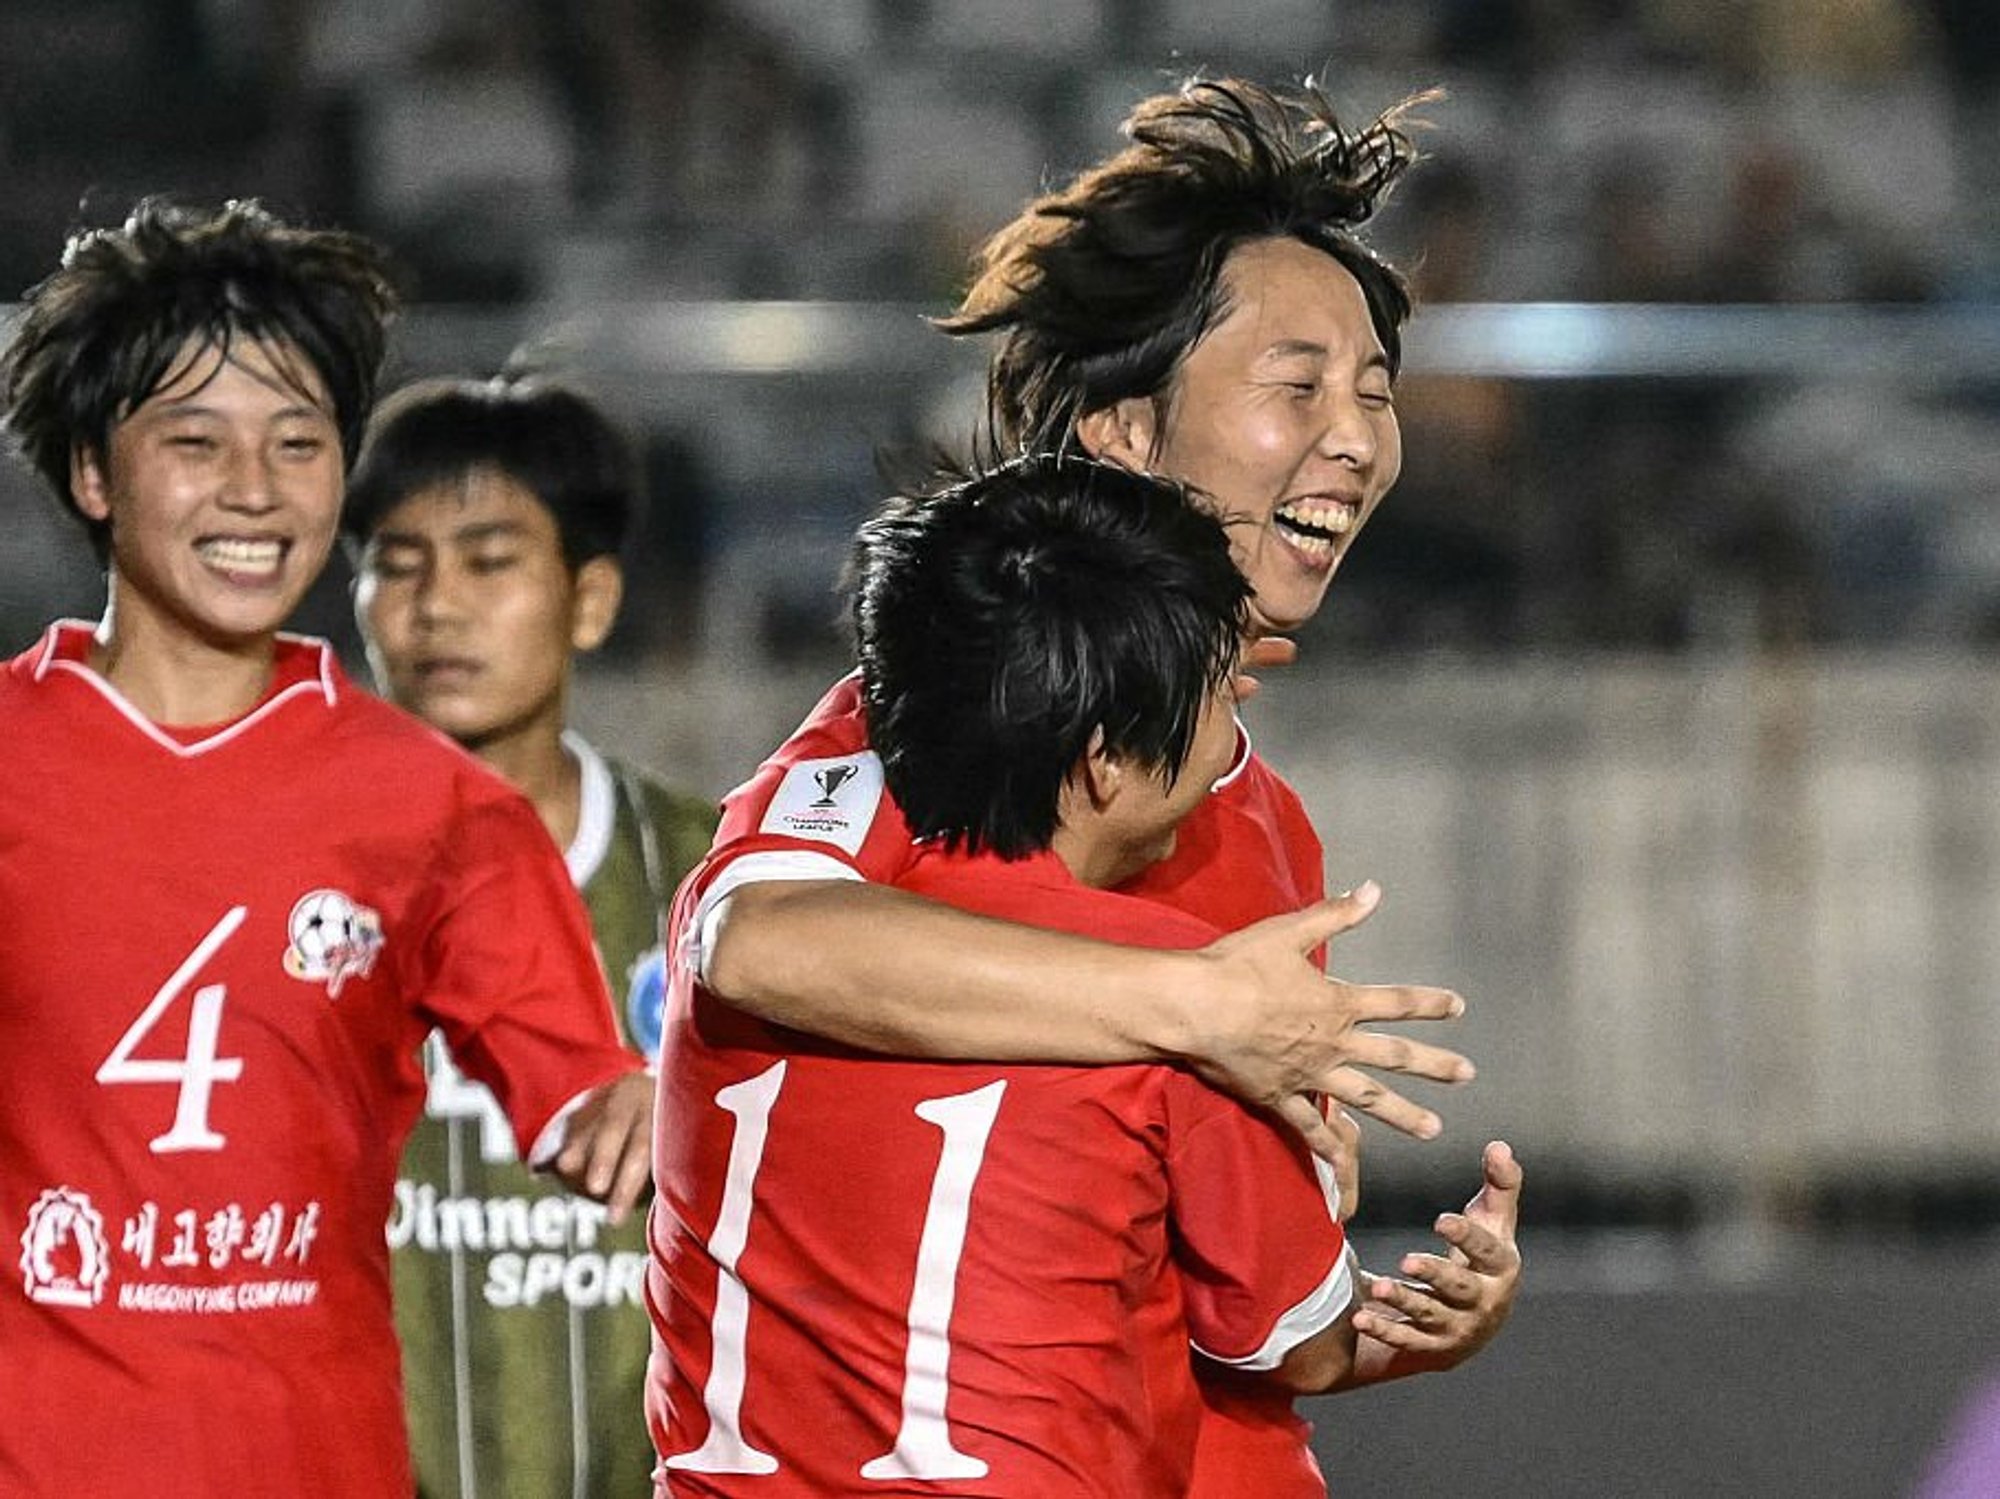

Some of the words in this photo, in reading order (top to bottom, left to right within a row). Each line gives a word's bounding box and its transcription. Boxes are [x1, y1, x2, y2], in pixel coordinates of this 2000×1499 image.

[95, 904, 248, 1154] 4
[121, 1200, 320, 1270] 내고향회사
[664, 1059, 1008, 1480] 11
[237, 1280, 318, 1310] COMPANY
[483, 1251, 652, 1307] SPOR
